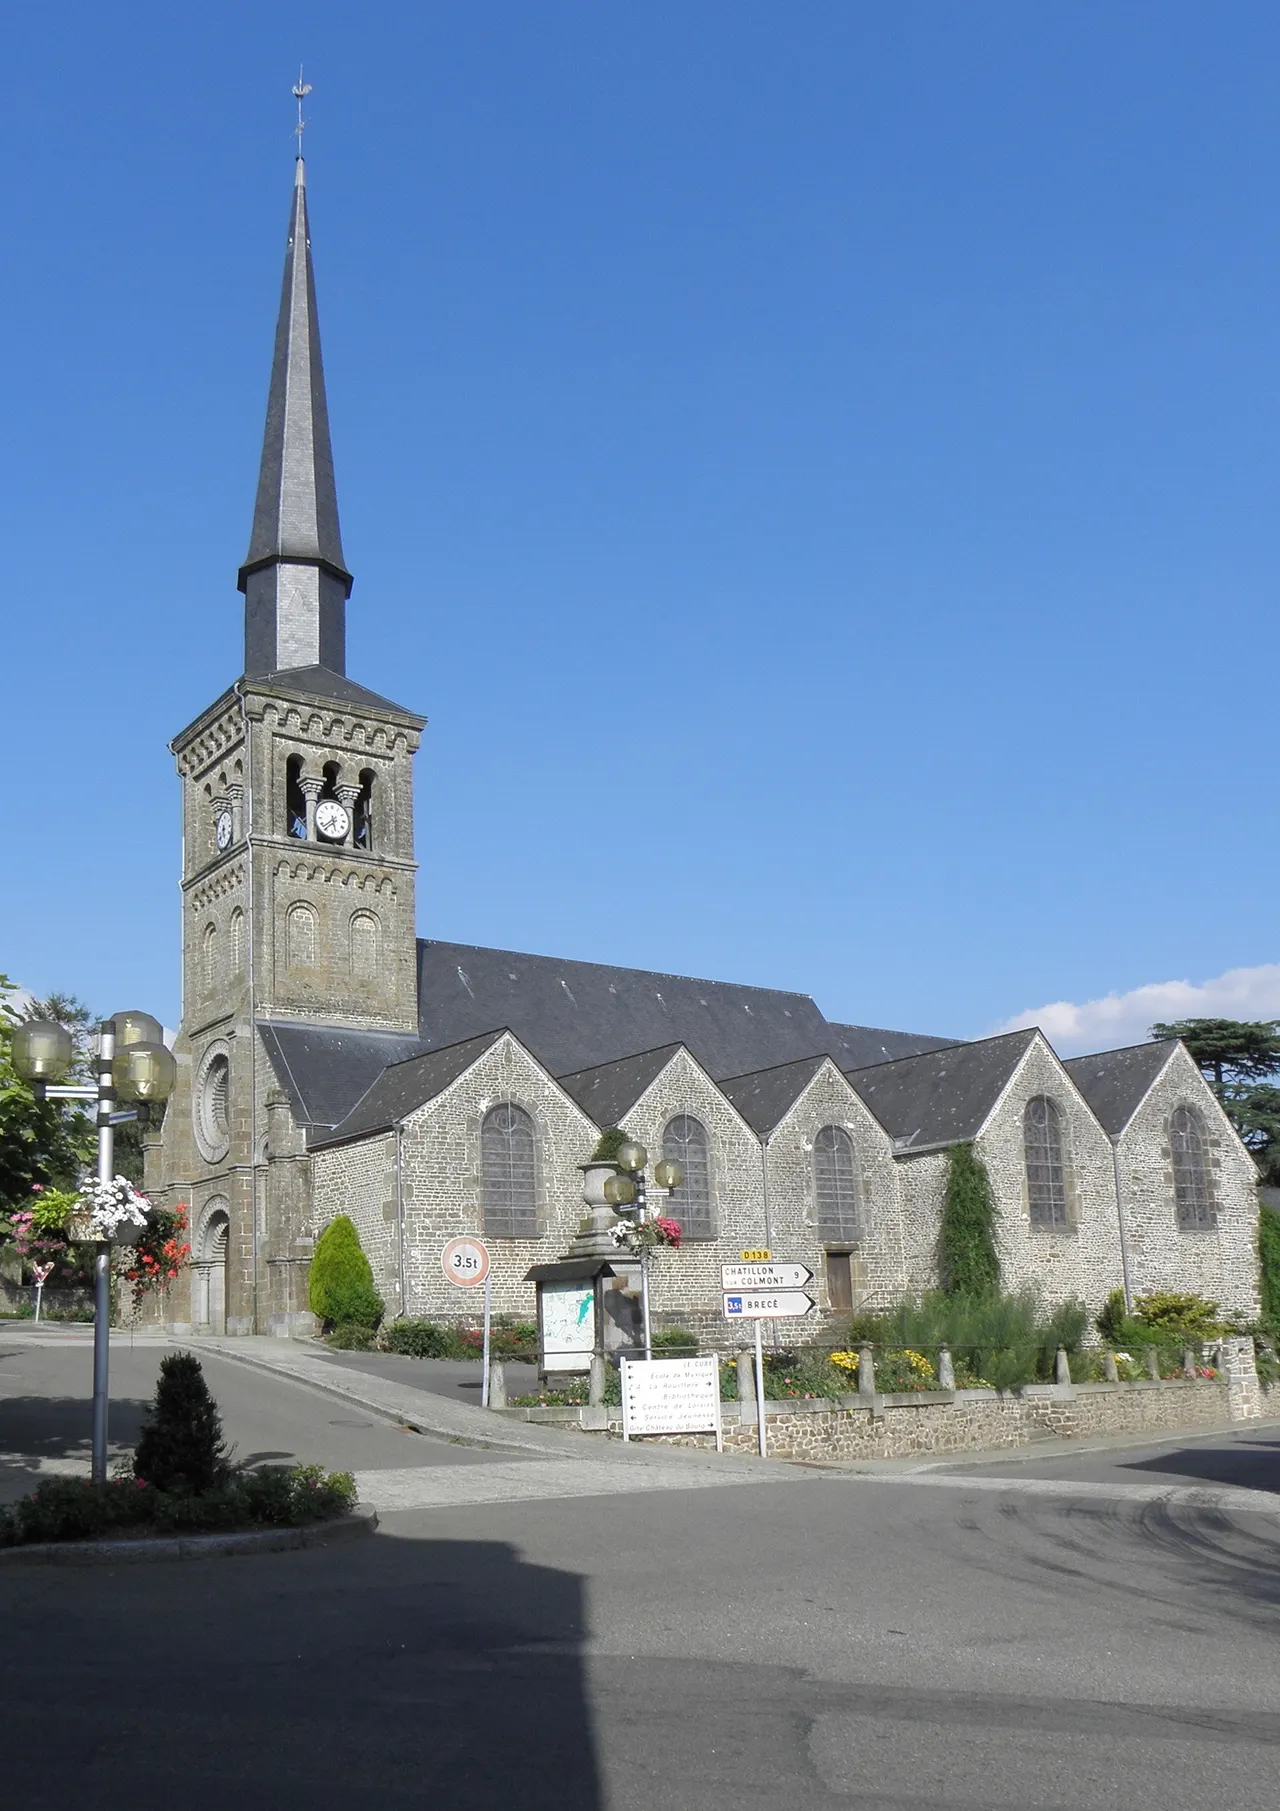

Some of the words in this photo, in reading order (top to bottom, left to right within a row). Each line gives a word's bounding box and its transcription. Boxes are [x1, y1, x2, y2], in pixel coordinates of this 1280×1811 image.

[744, 1251, 750, 1259] D
[752, 1251, 769, 1259] 138
[724, 1267, 774, 1276] CHATILLON
[793, 1271, 800, 1279] 9
[741, 1276, 784, 1285] COLMONT
[747, 1299, 779, 1309] BRECÉ
[642, 1403, 669, 1411] Centre
[679, 1412, 715, 1420] Jeunesse
